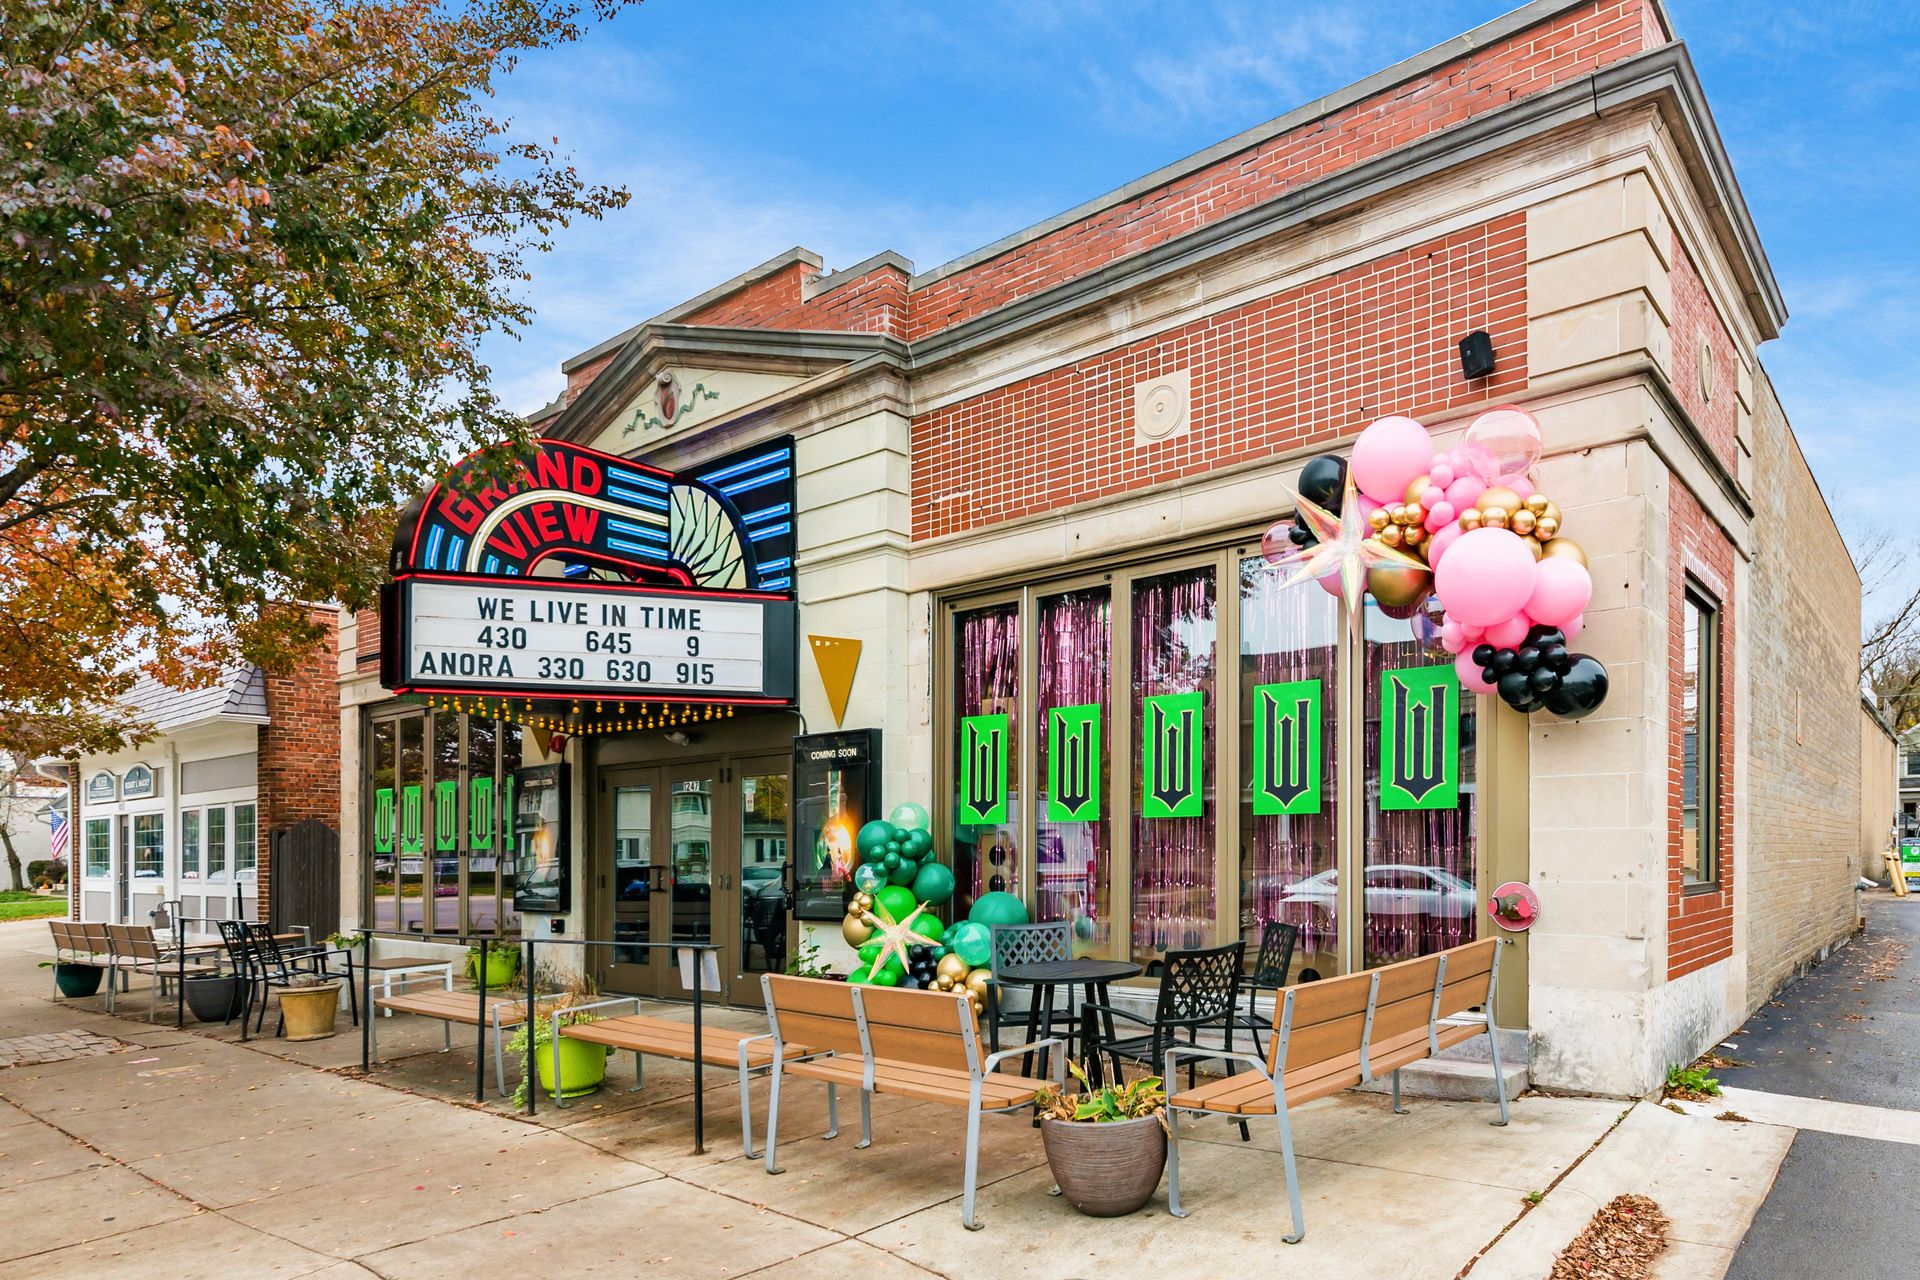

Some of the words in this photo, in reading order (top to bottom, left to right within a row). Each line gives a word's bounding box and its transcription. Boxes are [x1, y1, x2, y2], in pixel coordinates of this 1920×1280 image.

[487, 502, 599, 560] VIEW
[477, 597, 514, 621] WE
[530, 600, 588, 625] LIVE
[602, 604, 626, 627] IN
[640, 606, 701, 631] TIME
[477, 626, 527, 650] 430
[586, 630, 632, 654] 645
[686, 636, 700, 657] 9
[419, 651, 514, 679] ANORA
[538, 656, 584, 680] 330
[607, 659, 652, 683] 630
[676, 663, 714, 685] 915
[811, 750, 836, 760] COMING
[837, 747, 857, 758] SOON
